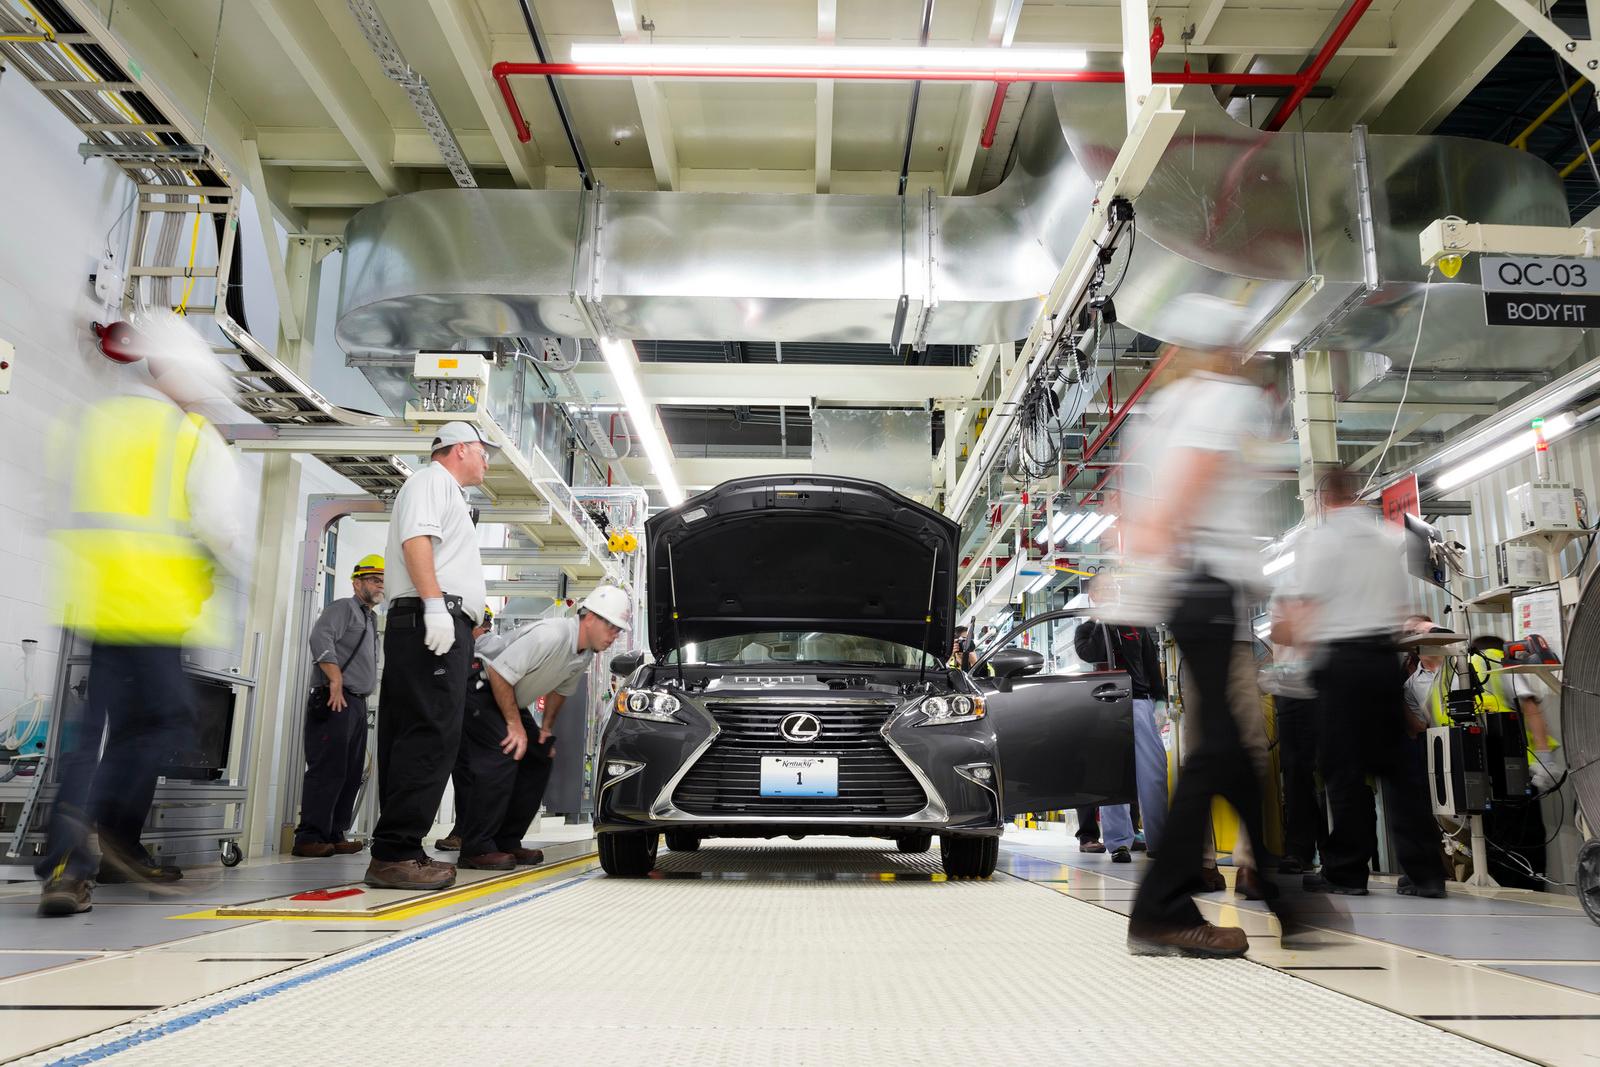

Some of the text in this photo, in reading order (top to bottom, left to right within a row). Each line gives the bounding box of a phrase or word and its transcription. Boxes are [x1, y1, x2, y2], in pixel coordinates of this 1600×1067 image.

[1498, 262, 1587, 287] QC-03
[1507, 303, 1586, 321] BODY FIT
[1388, 493, 1411, 521] EXIT
[782, 760, 813, 768] Kentucky
[796, 771, 803, 785] 1
